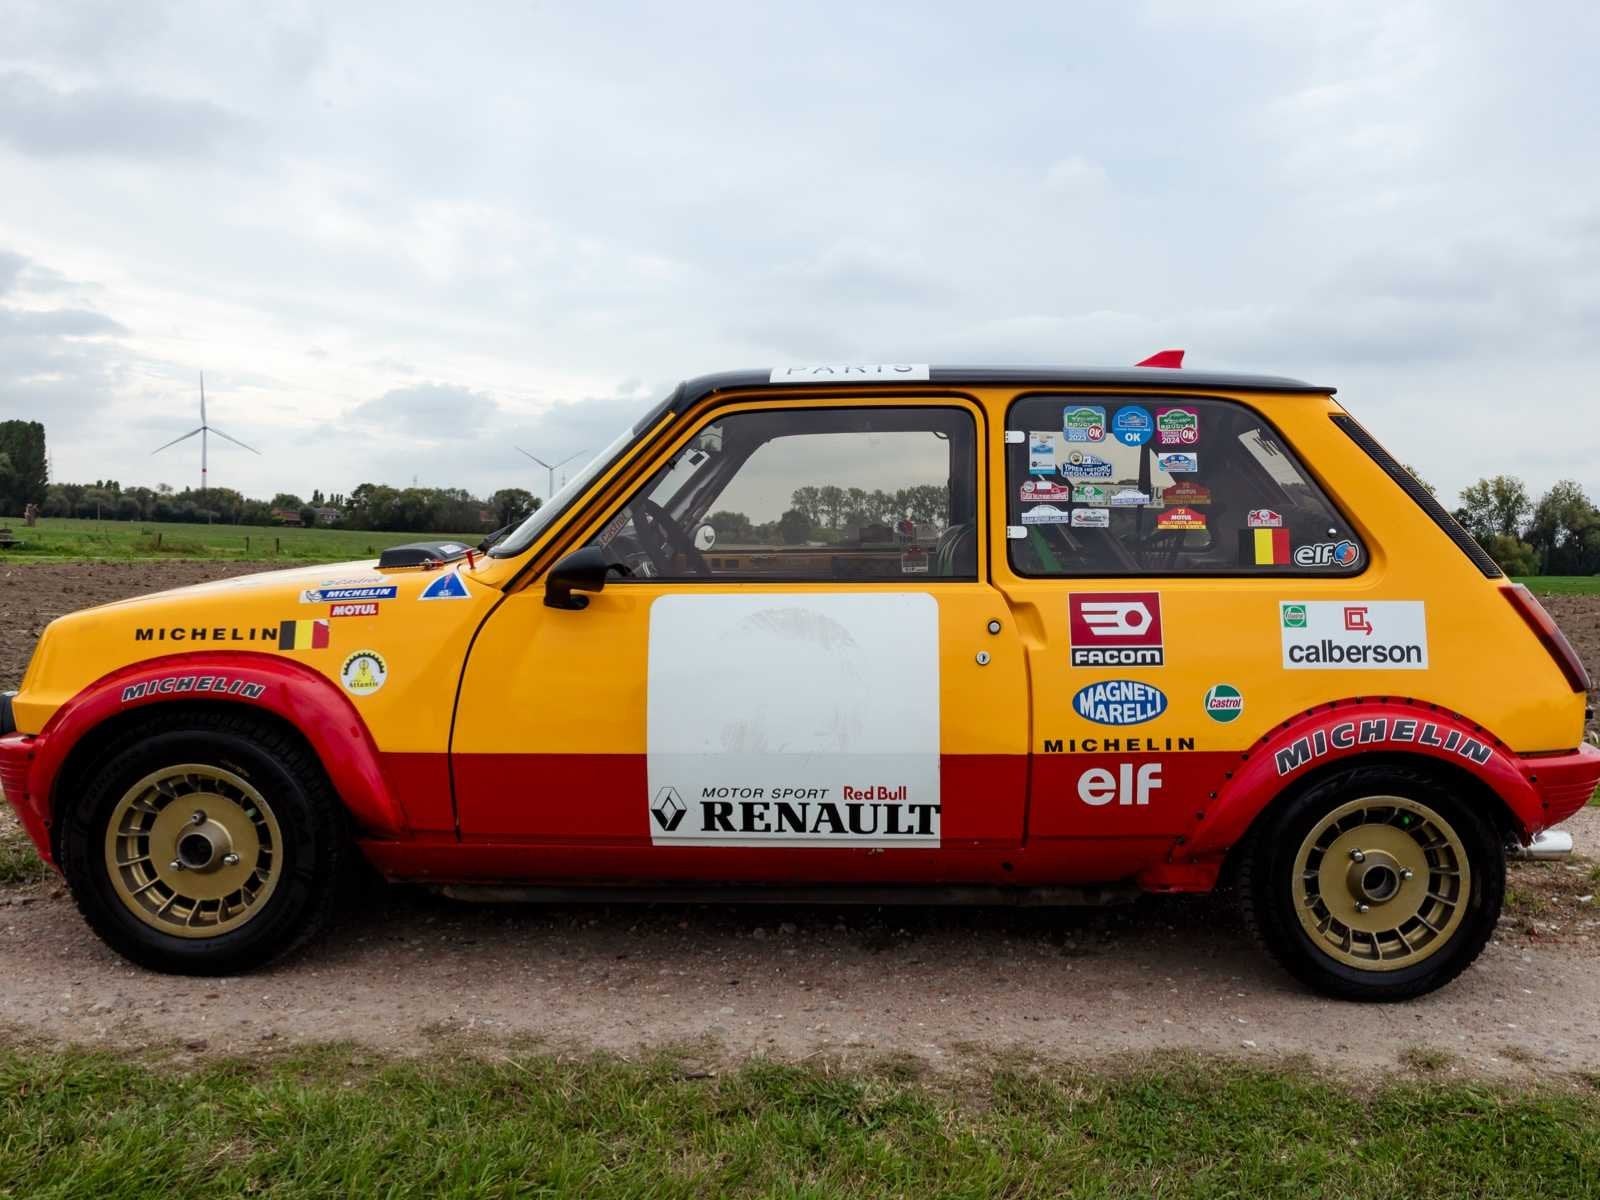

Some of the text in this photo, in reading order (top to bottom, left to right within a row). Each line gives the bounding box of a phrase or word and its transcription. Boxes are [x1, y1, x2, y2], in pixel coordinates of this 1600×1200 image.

[1088, 428, 1102, 439] OK
[1124, 432, 1141, 442] OK
[1182, 430, 1195, 440] OK
[1296, 544, 1335, 565] elf
[326, 588, 391, 599] MICHELIN
[332, 604, 377, 616] MOTUL
[135, 628, 279, 641] MICHELIN
[1074, 650, 1161, 664] FACOM
[1288, 639, 1422, 663] calberson
[121, 676, 265, 702] MICHELIN
[1080, 682, 1161, 708] MAGNETI
[1209, 698, 1242, 709] Castrol
[1044, 738, 1195, 752] MICHELIN
[1275, 718, 1493, 776] MICHELIN
[1077, 763, 1162, 806] elf
[702, 788, 830, 799] MOTOR SPORT
[843, 786, 907, 800] Red Bull
[699, 801, 941, 835] RENAULT
